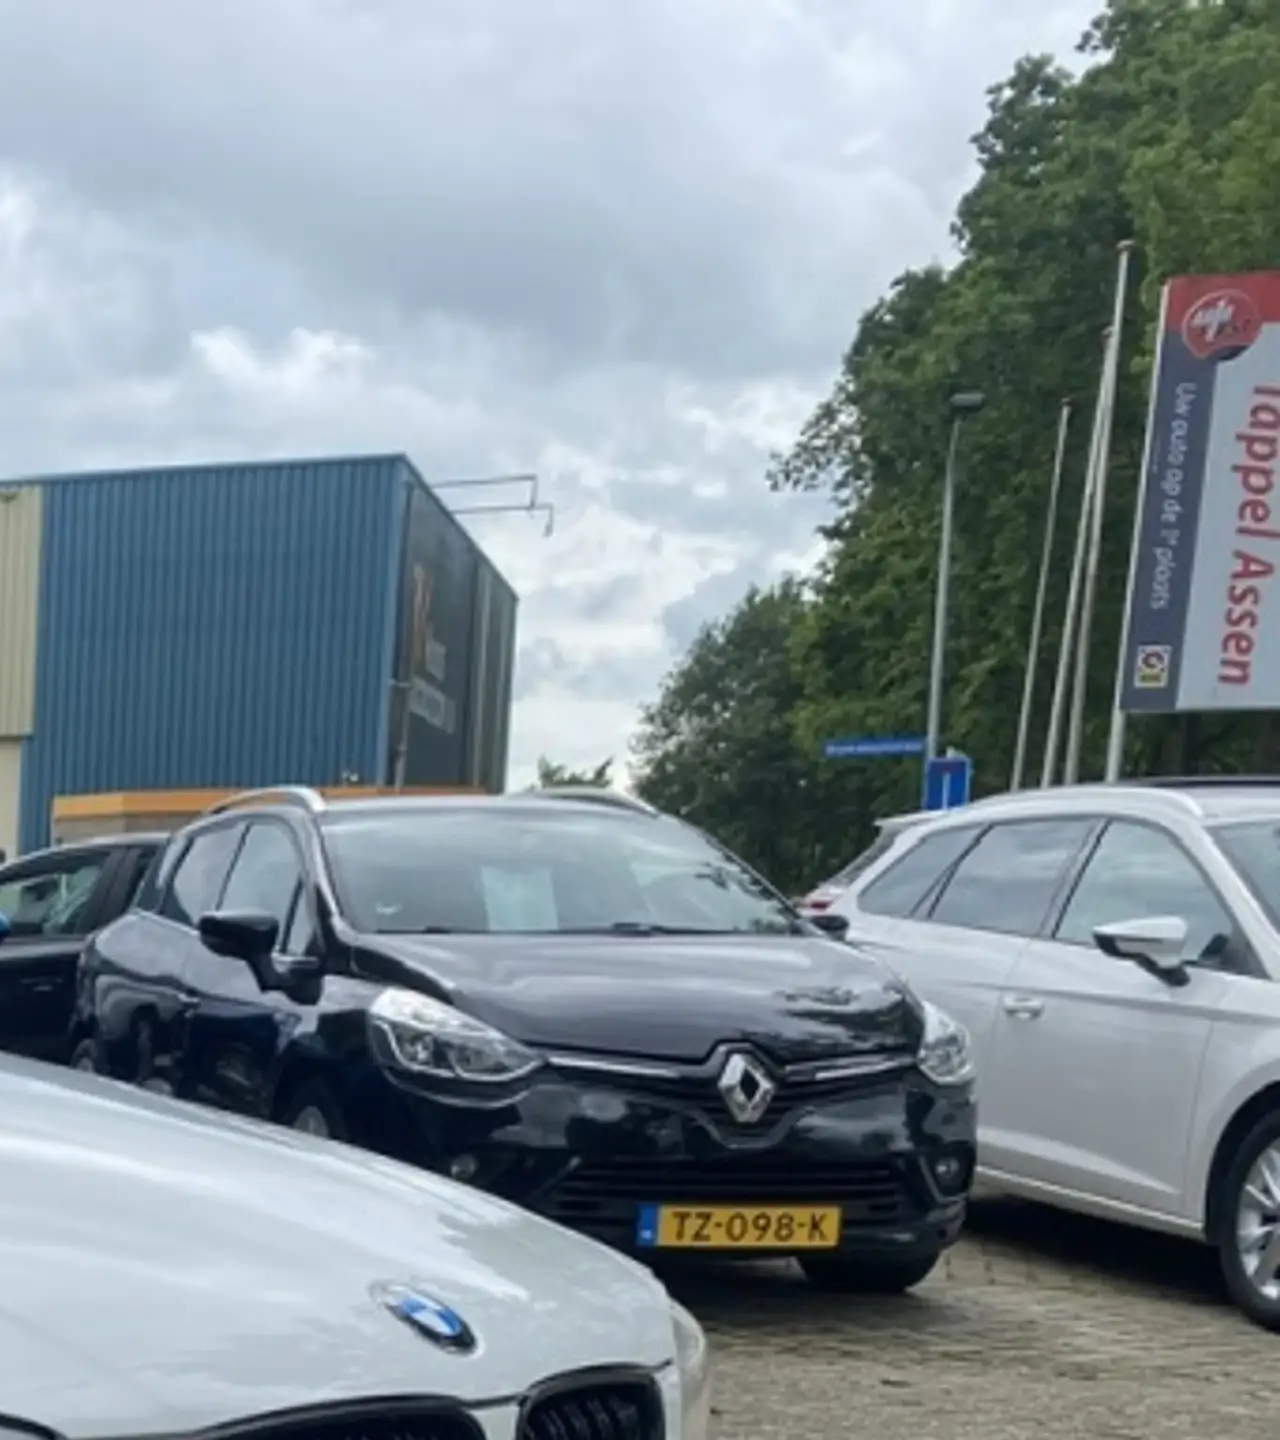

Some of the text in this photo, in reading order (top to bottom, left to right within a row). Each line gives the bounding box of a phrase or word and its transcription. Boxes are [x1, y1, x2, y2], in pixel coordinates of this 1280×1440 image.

[1175, 382, 1197, 416] Uw
[1167, 419, 1188, 466] auto
[1160, 468, 1184, 496] op
[1160, 499, 1183, 522] de
[1150, 547, 1177, 610] plaats
[1218, 549, 1276, 684] Assen
[672, 1211, 828, 1242] TZ-098-K
